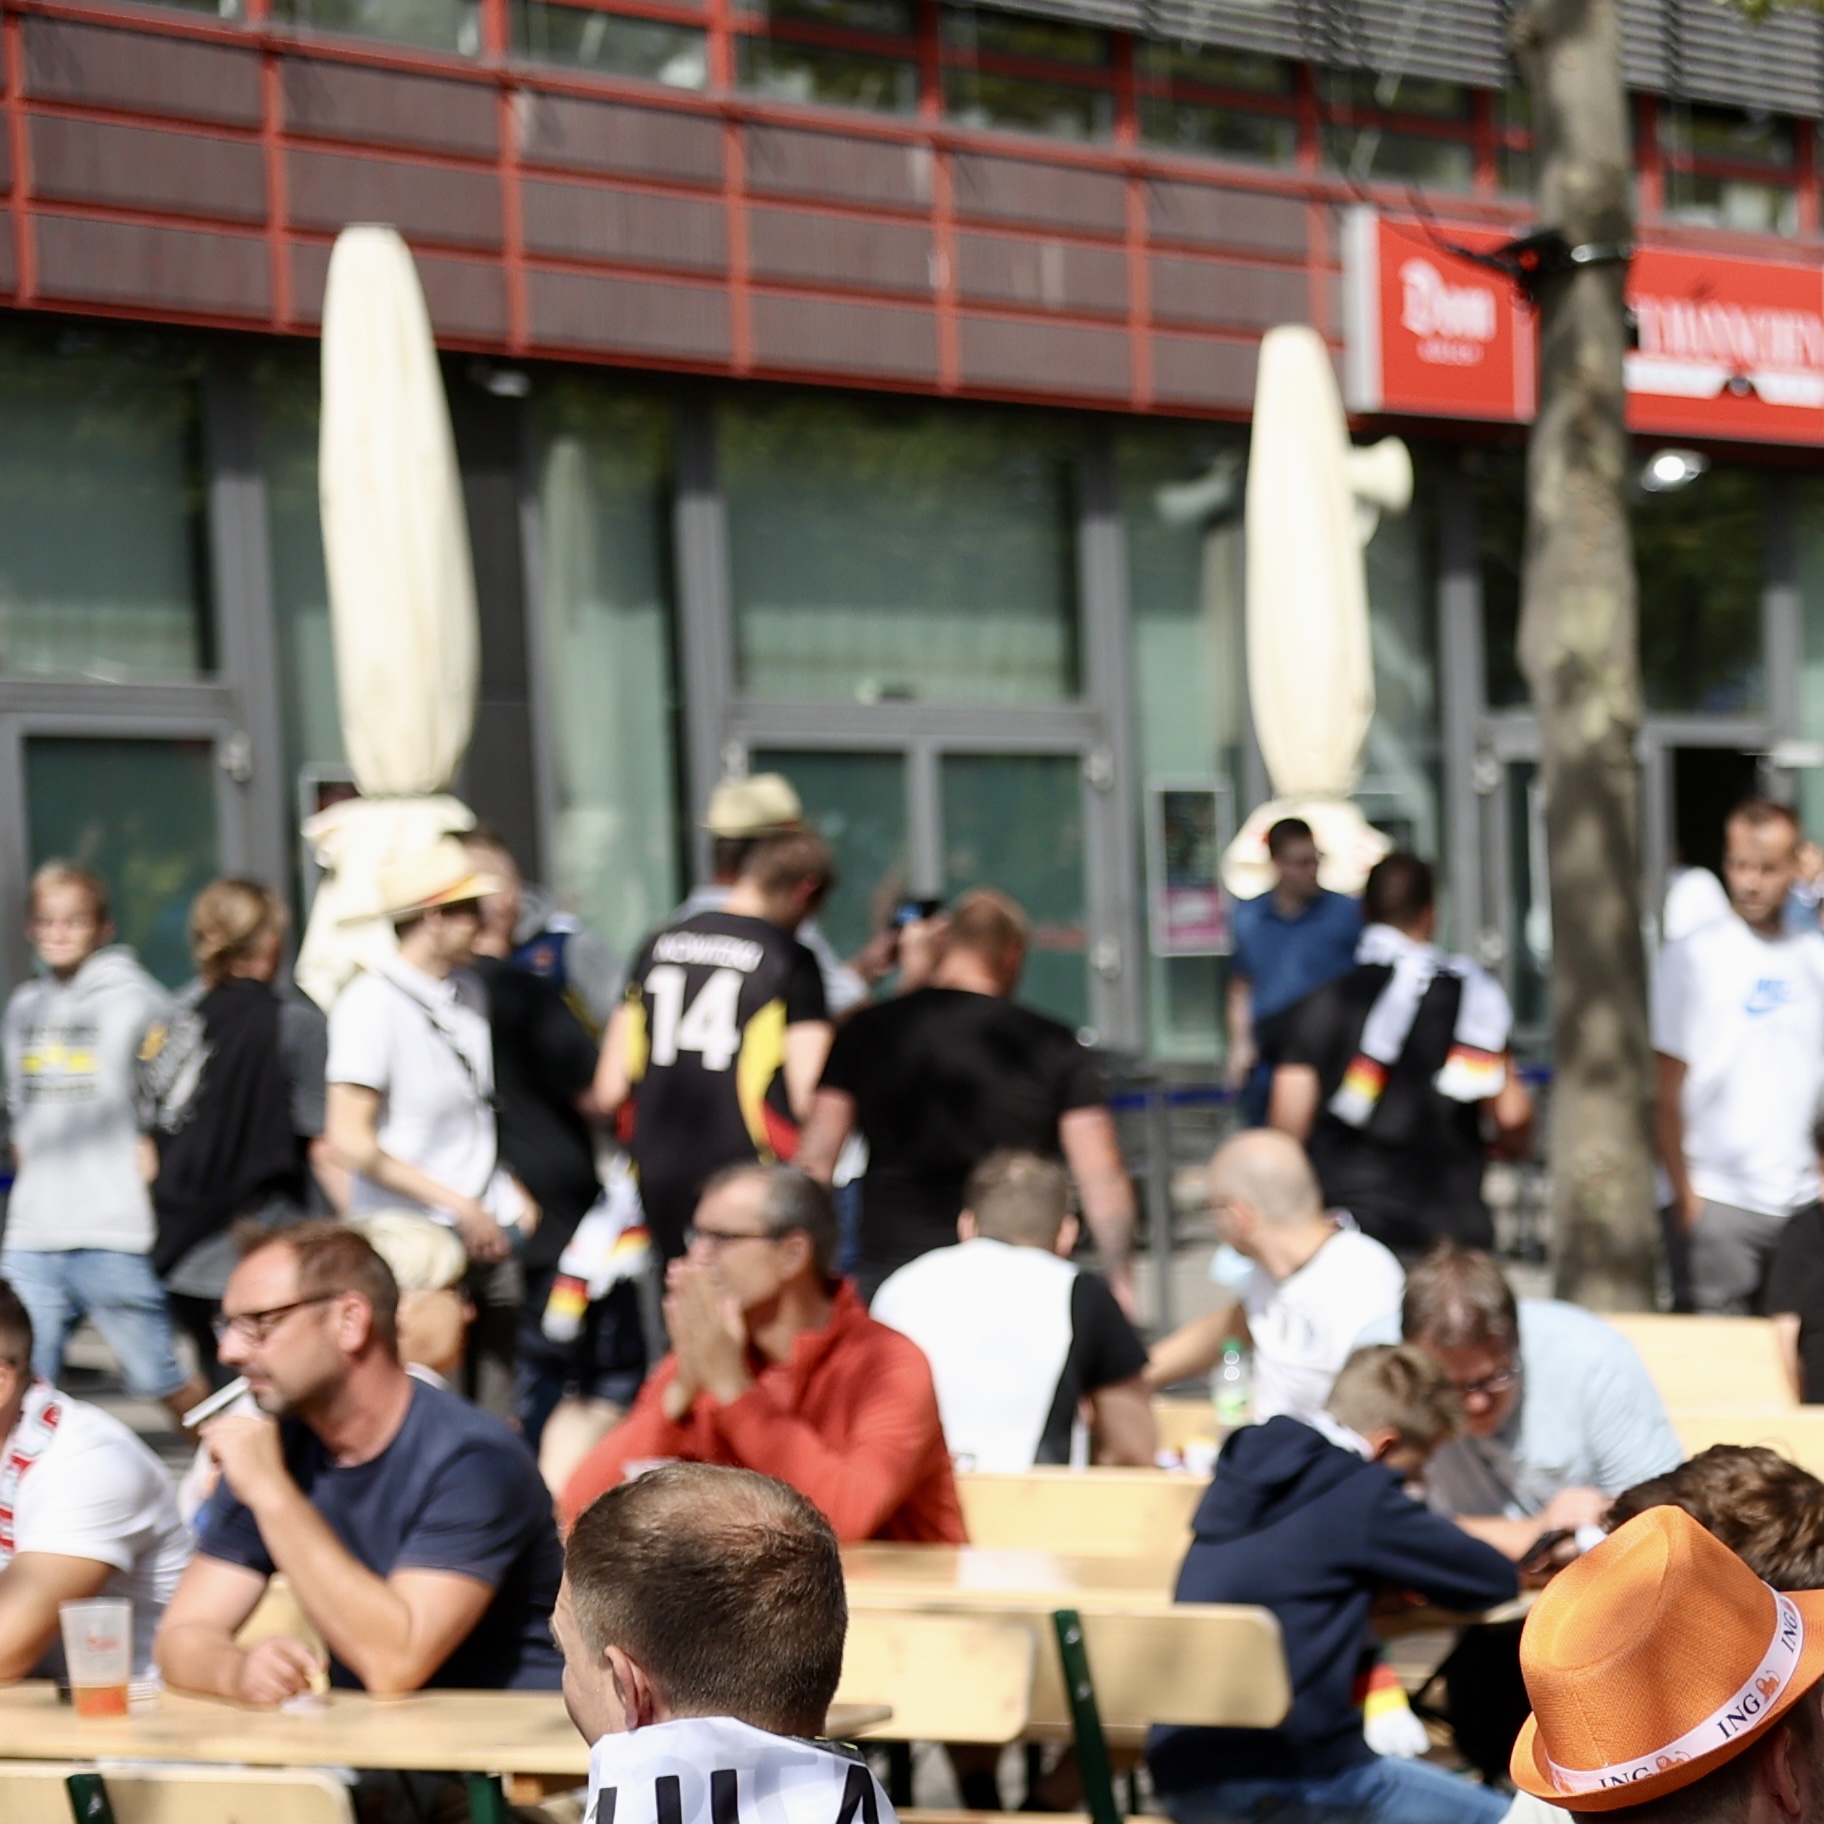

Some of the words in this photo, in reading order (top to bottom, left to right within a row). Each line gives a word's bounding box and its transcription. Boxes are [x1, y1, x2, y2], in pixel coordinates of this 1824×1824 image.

[645, 964, 744, 1071] 14
[1716, 1693, 1761, 1740] ING
[1781, 1611, 1799, 1654] ING
